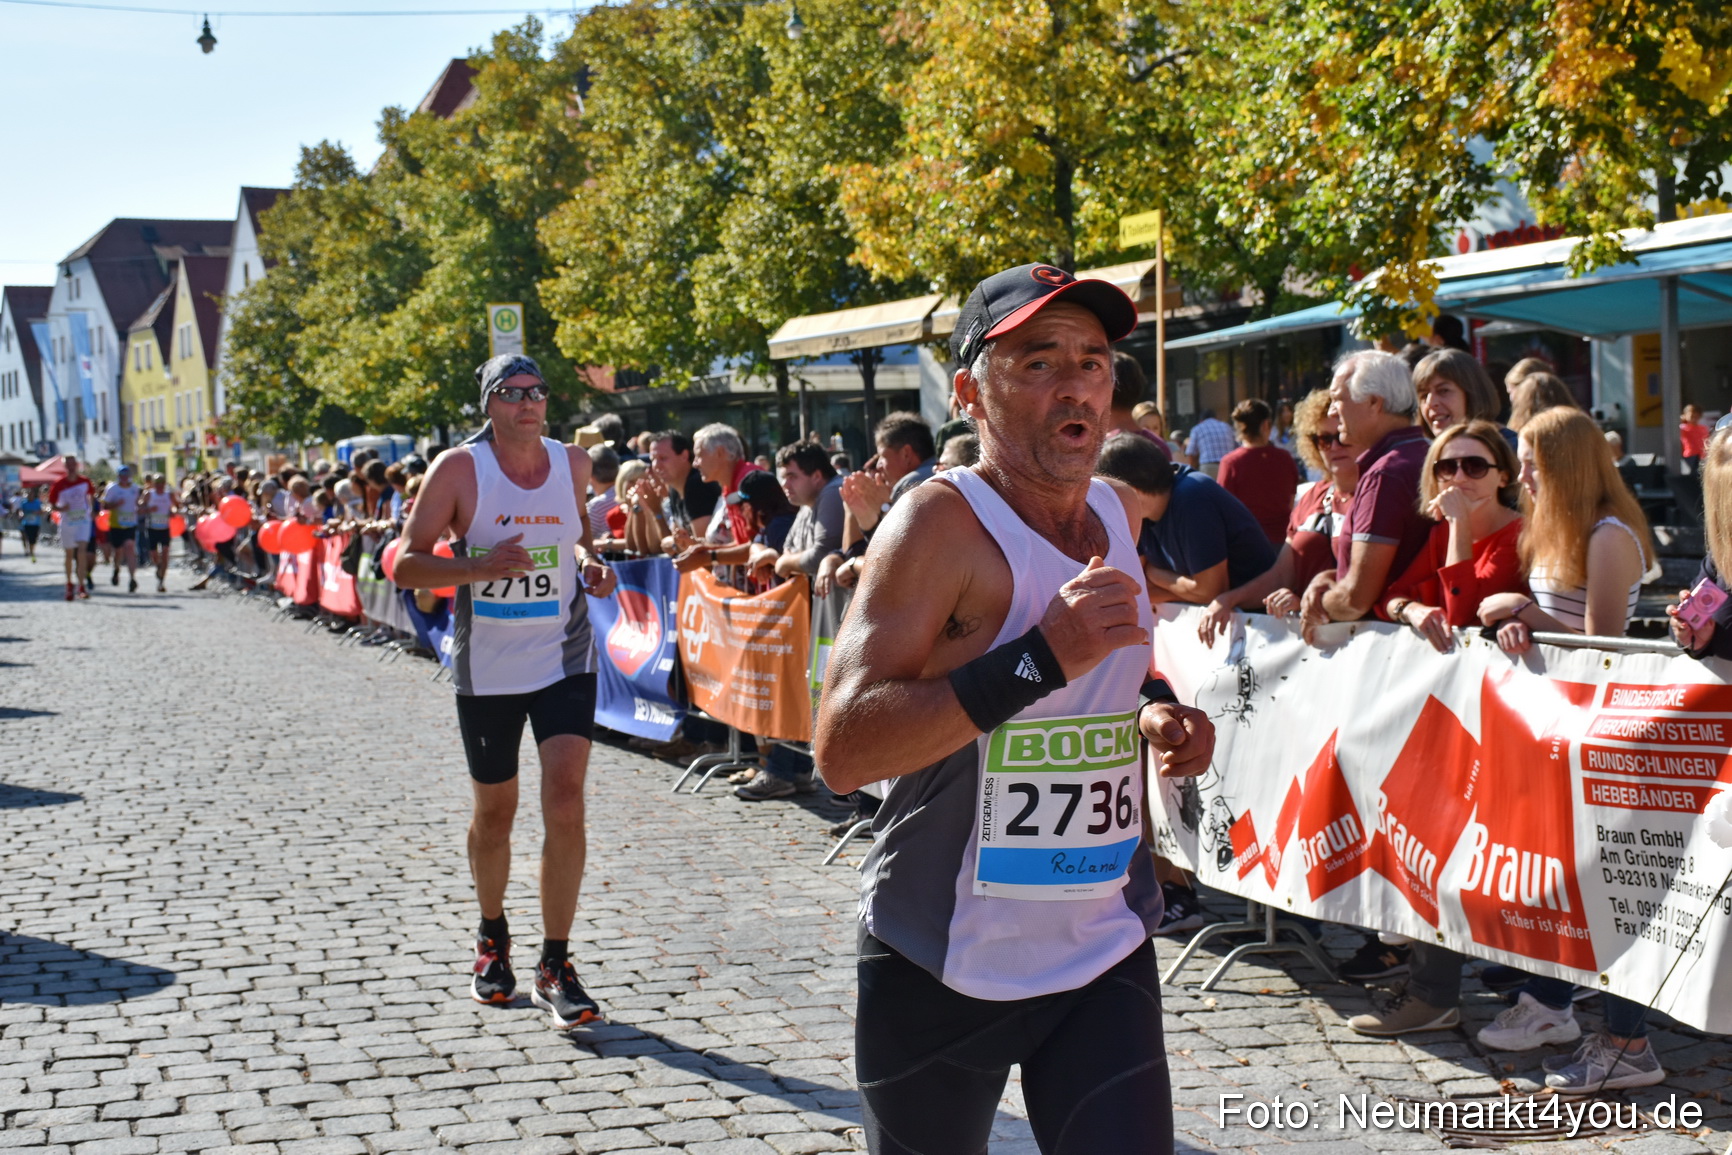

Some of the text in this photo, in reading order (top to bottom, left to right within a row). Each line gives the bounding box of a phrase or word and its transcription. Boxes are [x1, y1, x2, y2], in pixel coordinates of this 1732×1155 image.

[514, 515, 564, 526] KLEBL
[480, 573, 552, 598] 2719
[1022, 652, 1043, 683] adidas
[1006, 723, 1136, 764] BOCK
[1588, 749, 1717, 777] RUNDSCHLINGEN
[1005, 775, 1133, 837] 2736
[1591, 784, 1696, 809] HEBEBÄNDER
[1295, 813, 1361, 874] Braun
[1376, 789, 1437, 890] Braun
[1597, 824, 1684, 849] Braun GmbH
[1051, 851, 1120, 875] Roland
[1459, 822, 1571, 913] Braun
[1600, 846, 1694, 876] Am Grünberg 8
[1602, 867, 1657, 888] D-92318
[1608, 896, 1634, 915] Tel.
[1637, 899, 1667, 922] 09181
[1501, 909, 1591, 940] Sicher ist sicher
[1614, 917, 1637, 937] Fax
[1640, 921, 1667, 945] 09181
